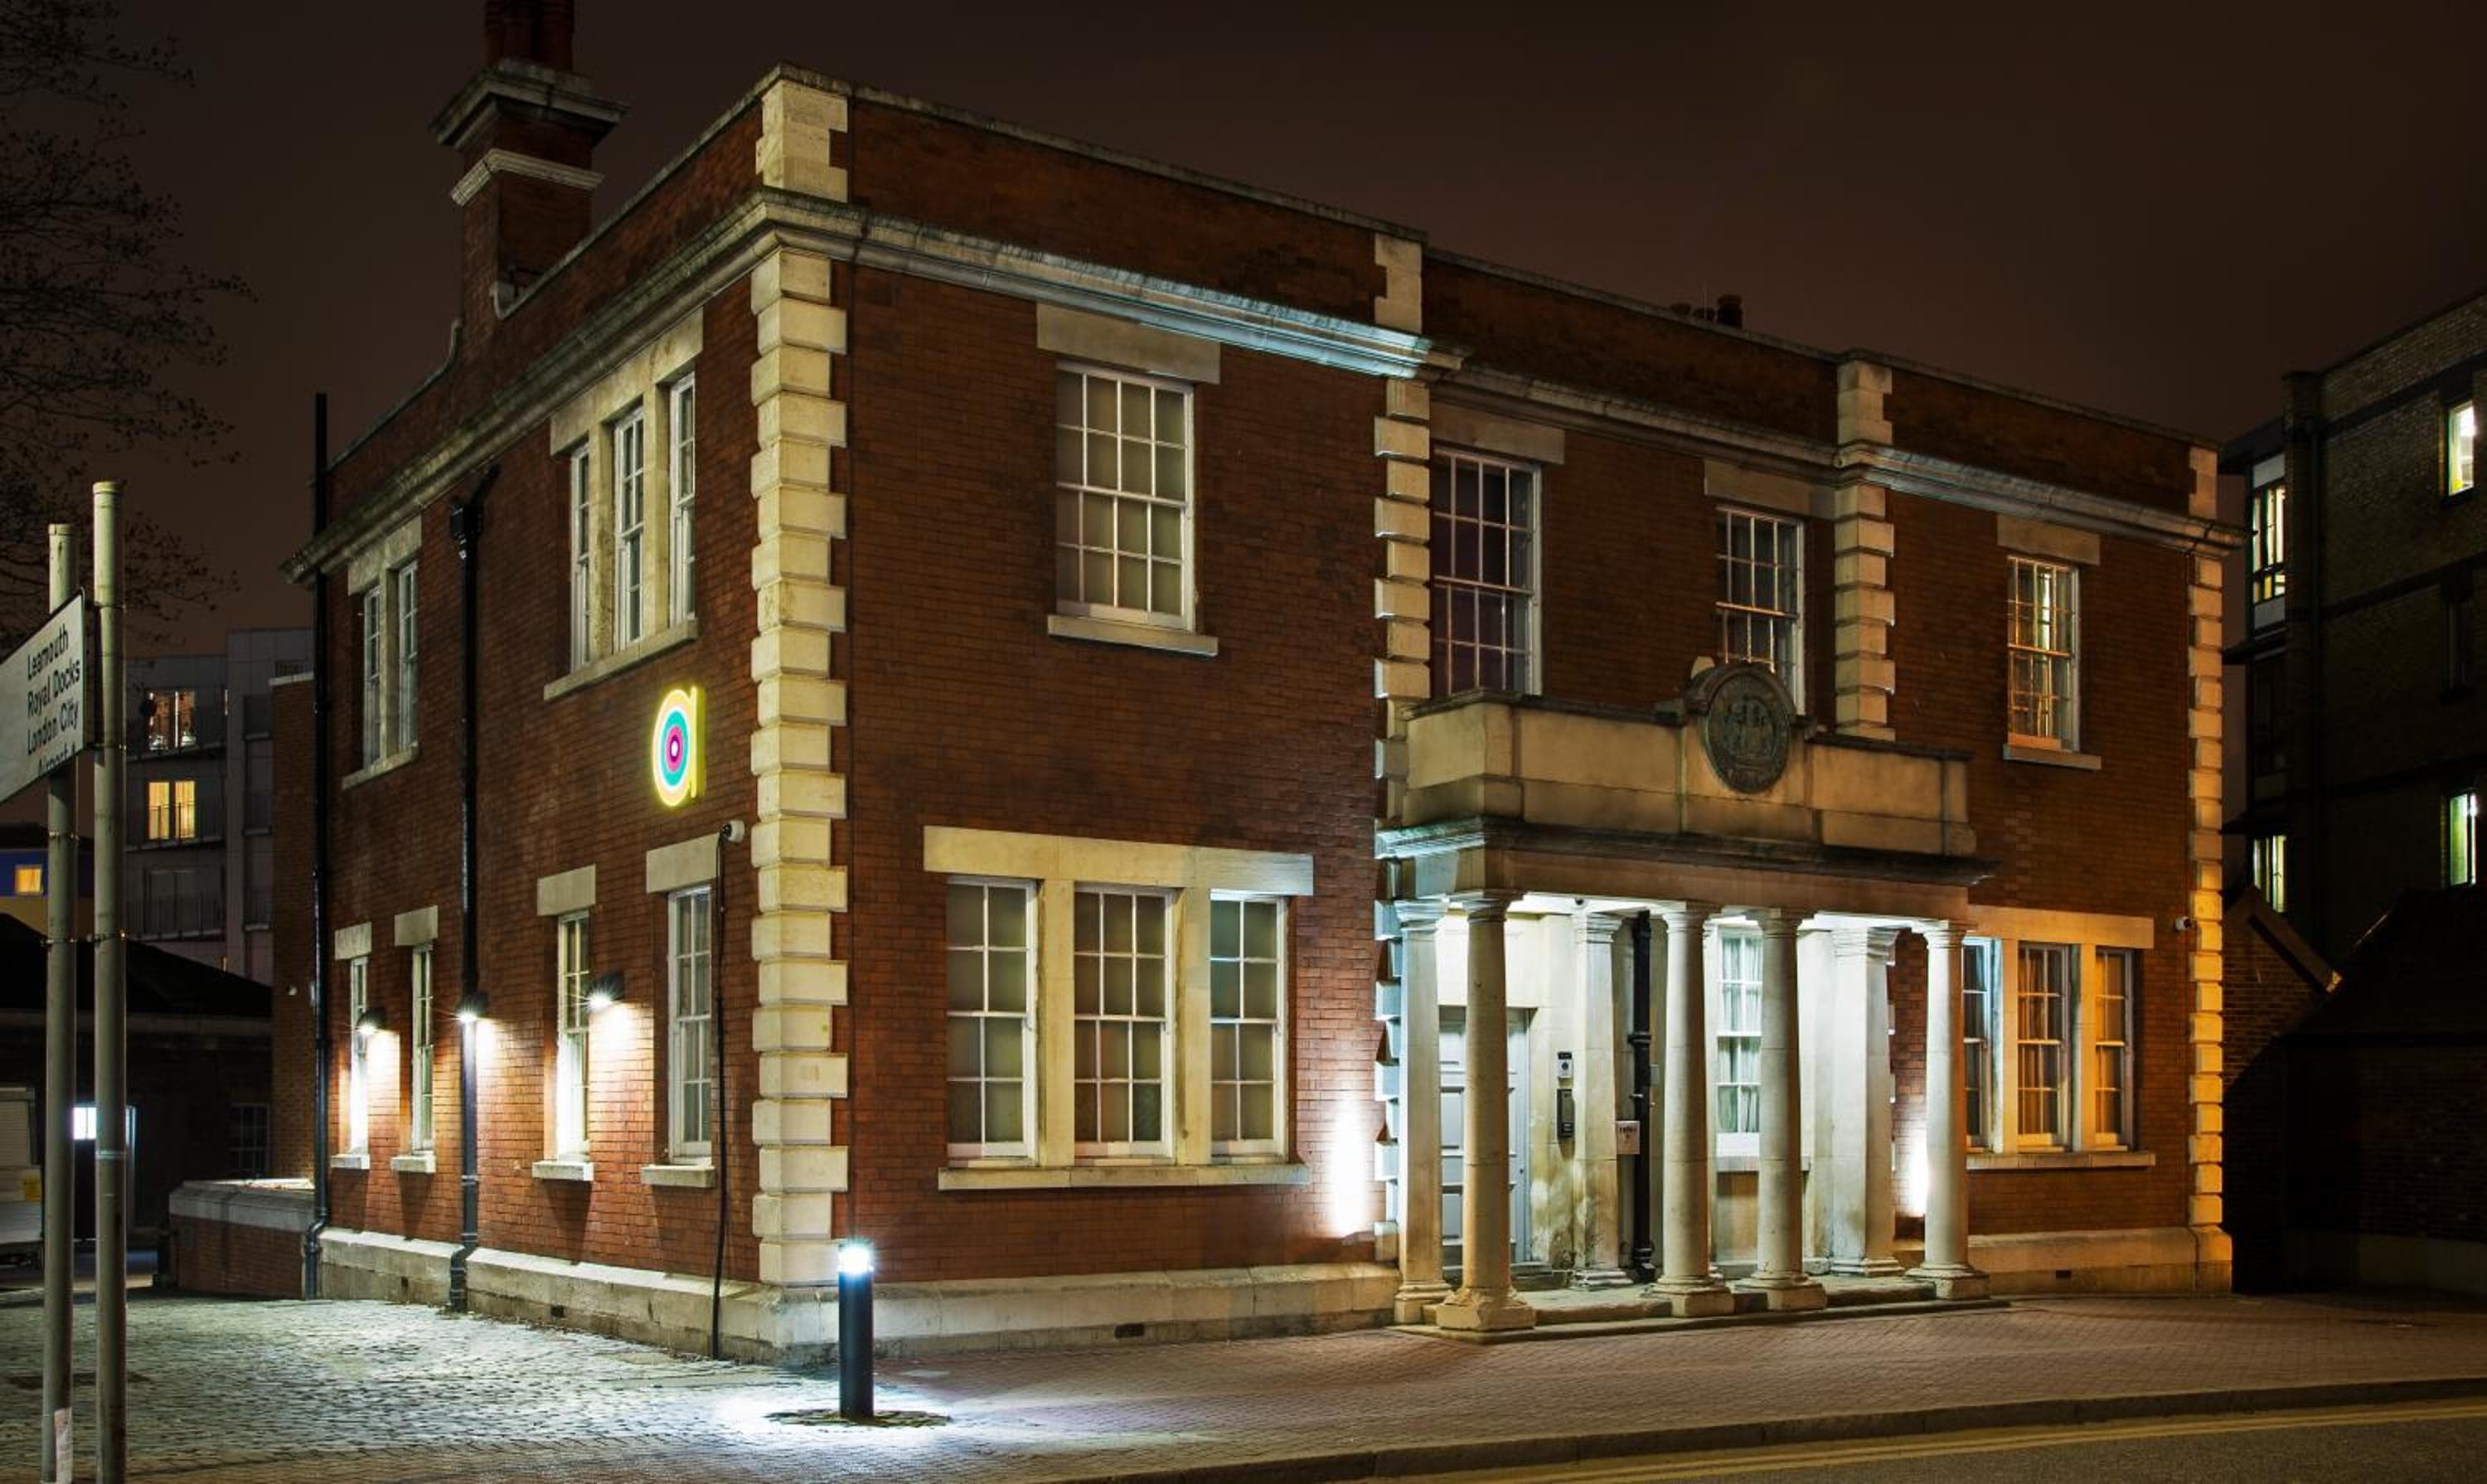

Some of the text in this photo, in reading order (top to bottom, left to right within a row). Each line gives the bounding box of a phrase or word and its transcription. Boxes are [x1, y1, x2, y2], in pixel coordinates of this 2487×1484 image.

[27, 623, 69, 681] Leamouth
[27, 658, 80, 717] Royal Docks
[27, 698, 79, 756] London City
